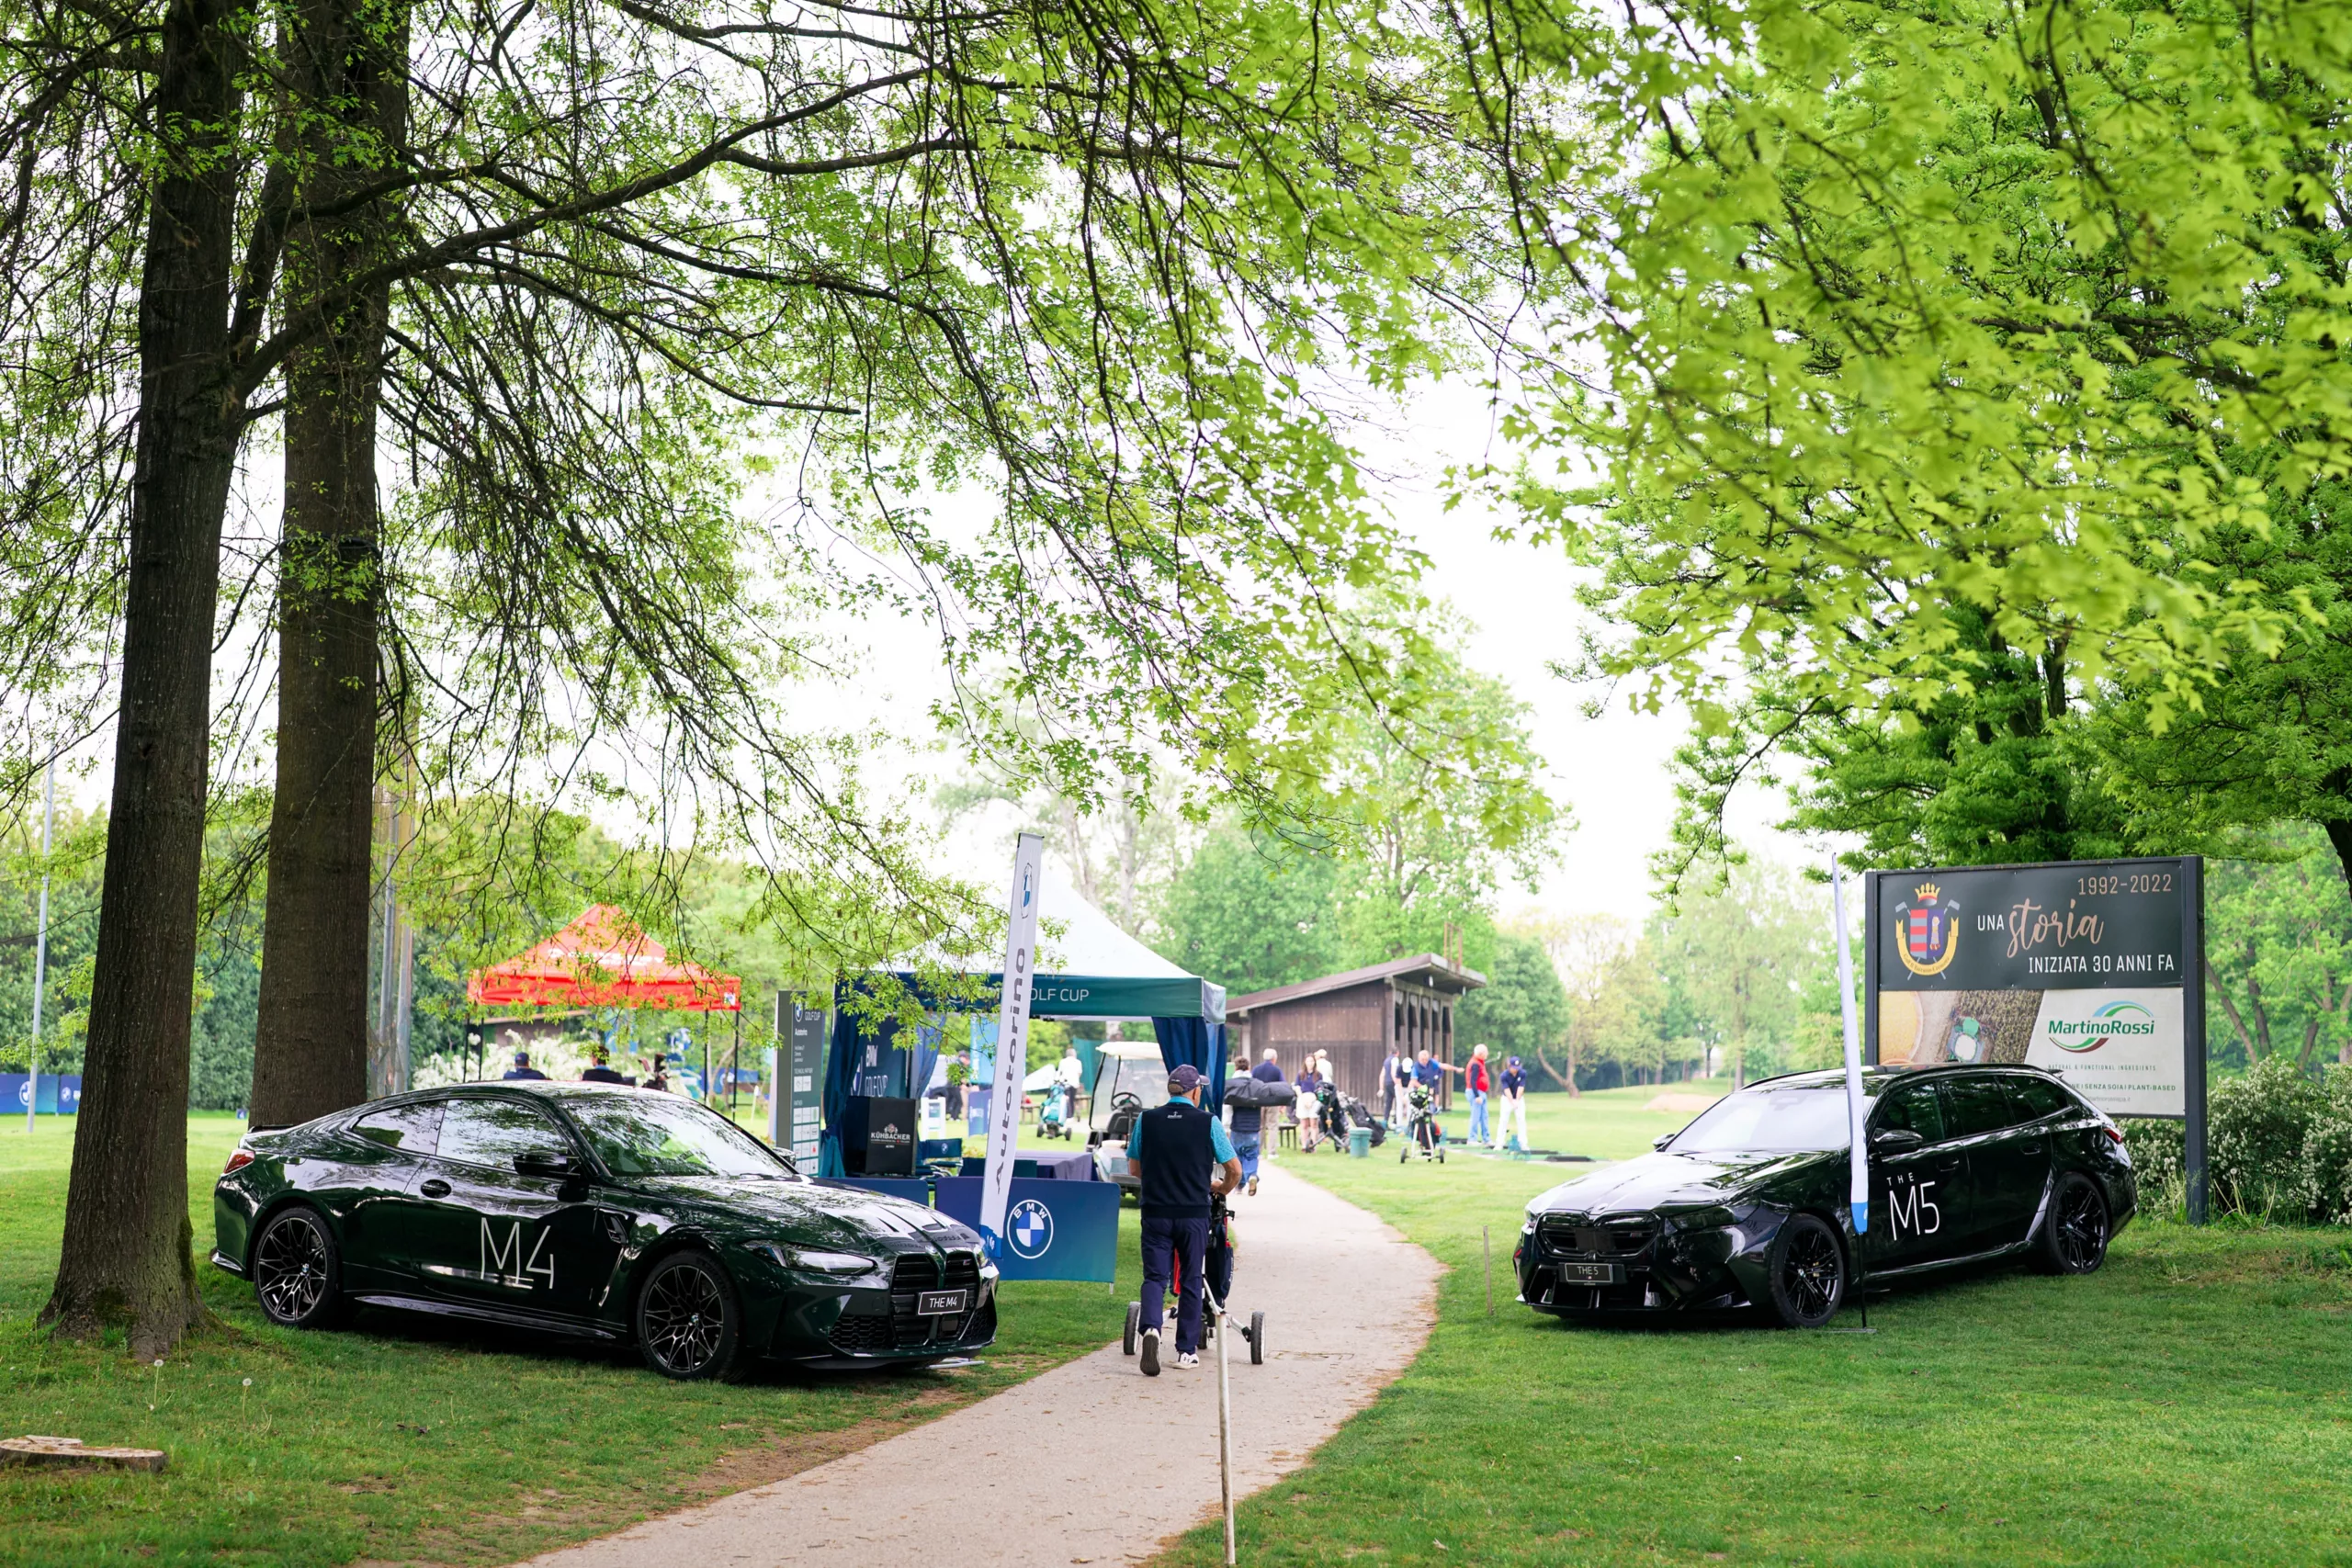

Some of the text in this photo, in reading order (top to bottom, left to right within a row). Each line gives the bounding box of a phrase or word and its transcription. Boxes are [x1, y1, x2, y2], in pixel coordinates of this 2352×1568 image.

[2078, 874, 2172, 896] 1992-2022
[1977, 897, 2105, 959] UNA storia
[2029, 953, 2175, 974] INIZIATA 30 ANNI FA
[1030, 988, 1090, 1002] OLF CUP
[2048, 1020, 2155, 1035] MartinoRossi
[1886, 1172, 1915, 1187] THE
[1013, 1202, 1047, 1219] BMW
[1889, 1180, 1939, 1241] M5
[480, 1217, 555, 1290] M4
[1577, 1266, 1592, 1275] THE
[929, 1296, 957, 1308] THE M4
